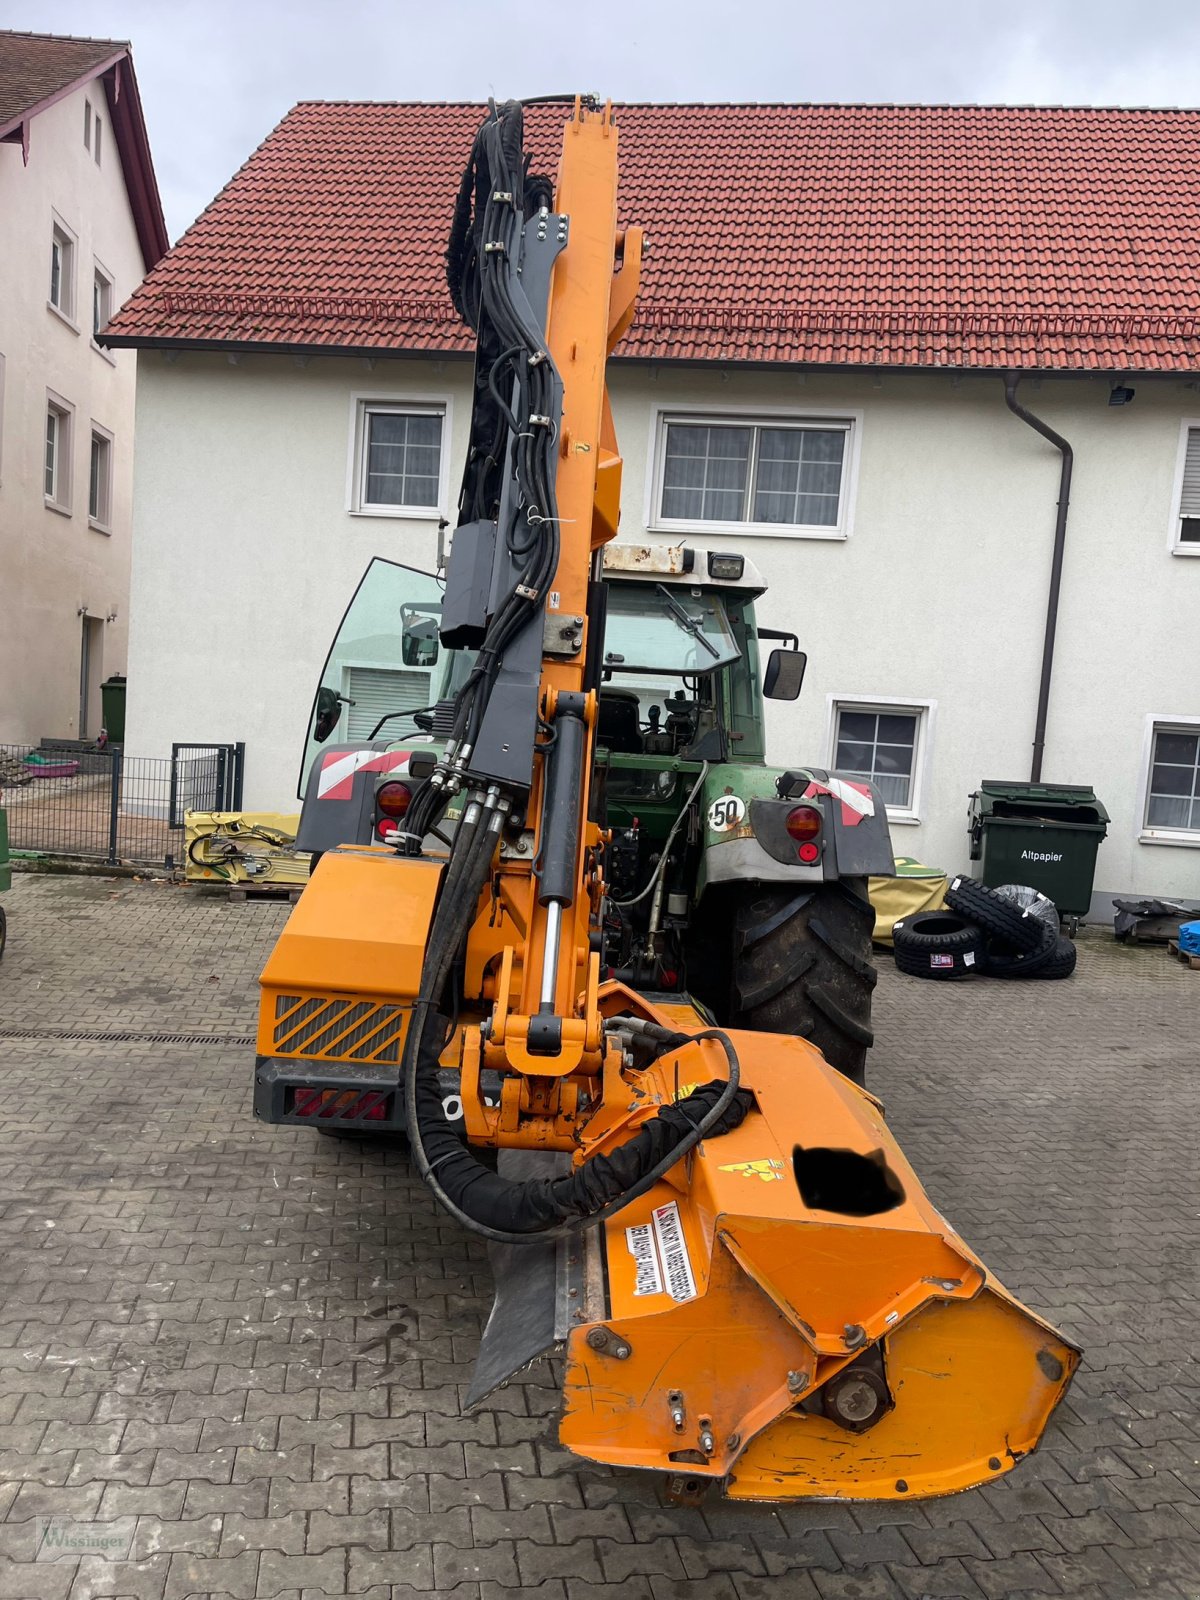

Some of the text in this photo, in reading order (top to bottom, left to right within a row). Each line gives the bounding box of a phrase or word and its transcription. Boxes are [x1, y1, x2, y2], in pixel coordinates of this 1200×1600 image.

[714, 800, 738, 827] 50
[1021, 850, 1063, 863] Altpapier
[630, 1225, 649, 1238] DER
[658, 1212, 693, 1300] SICH NICHT IN ARBEITSBEREICH
[636, 1260, 658, 1295] AUFHALTEN
